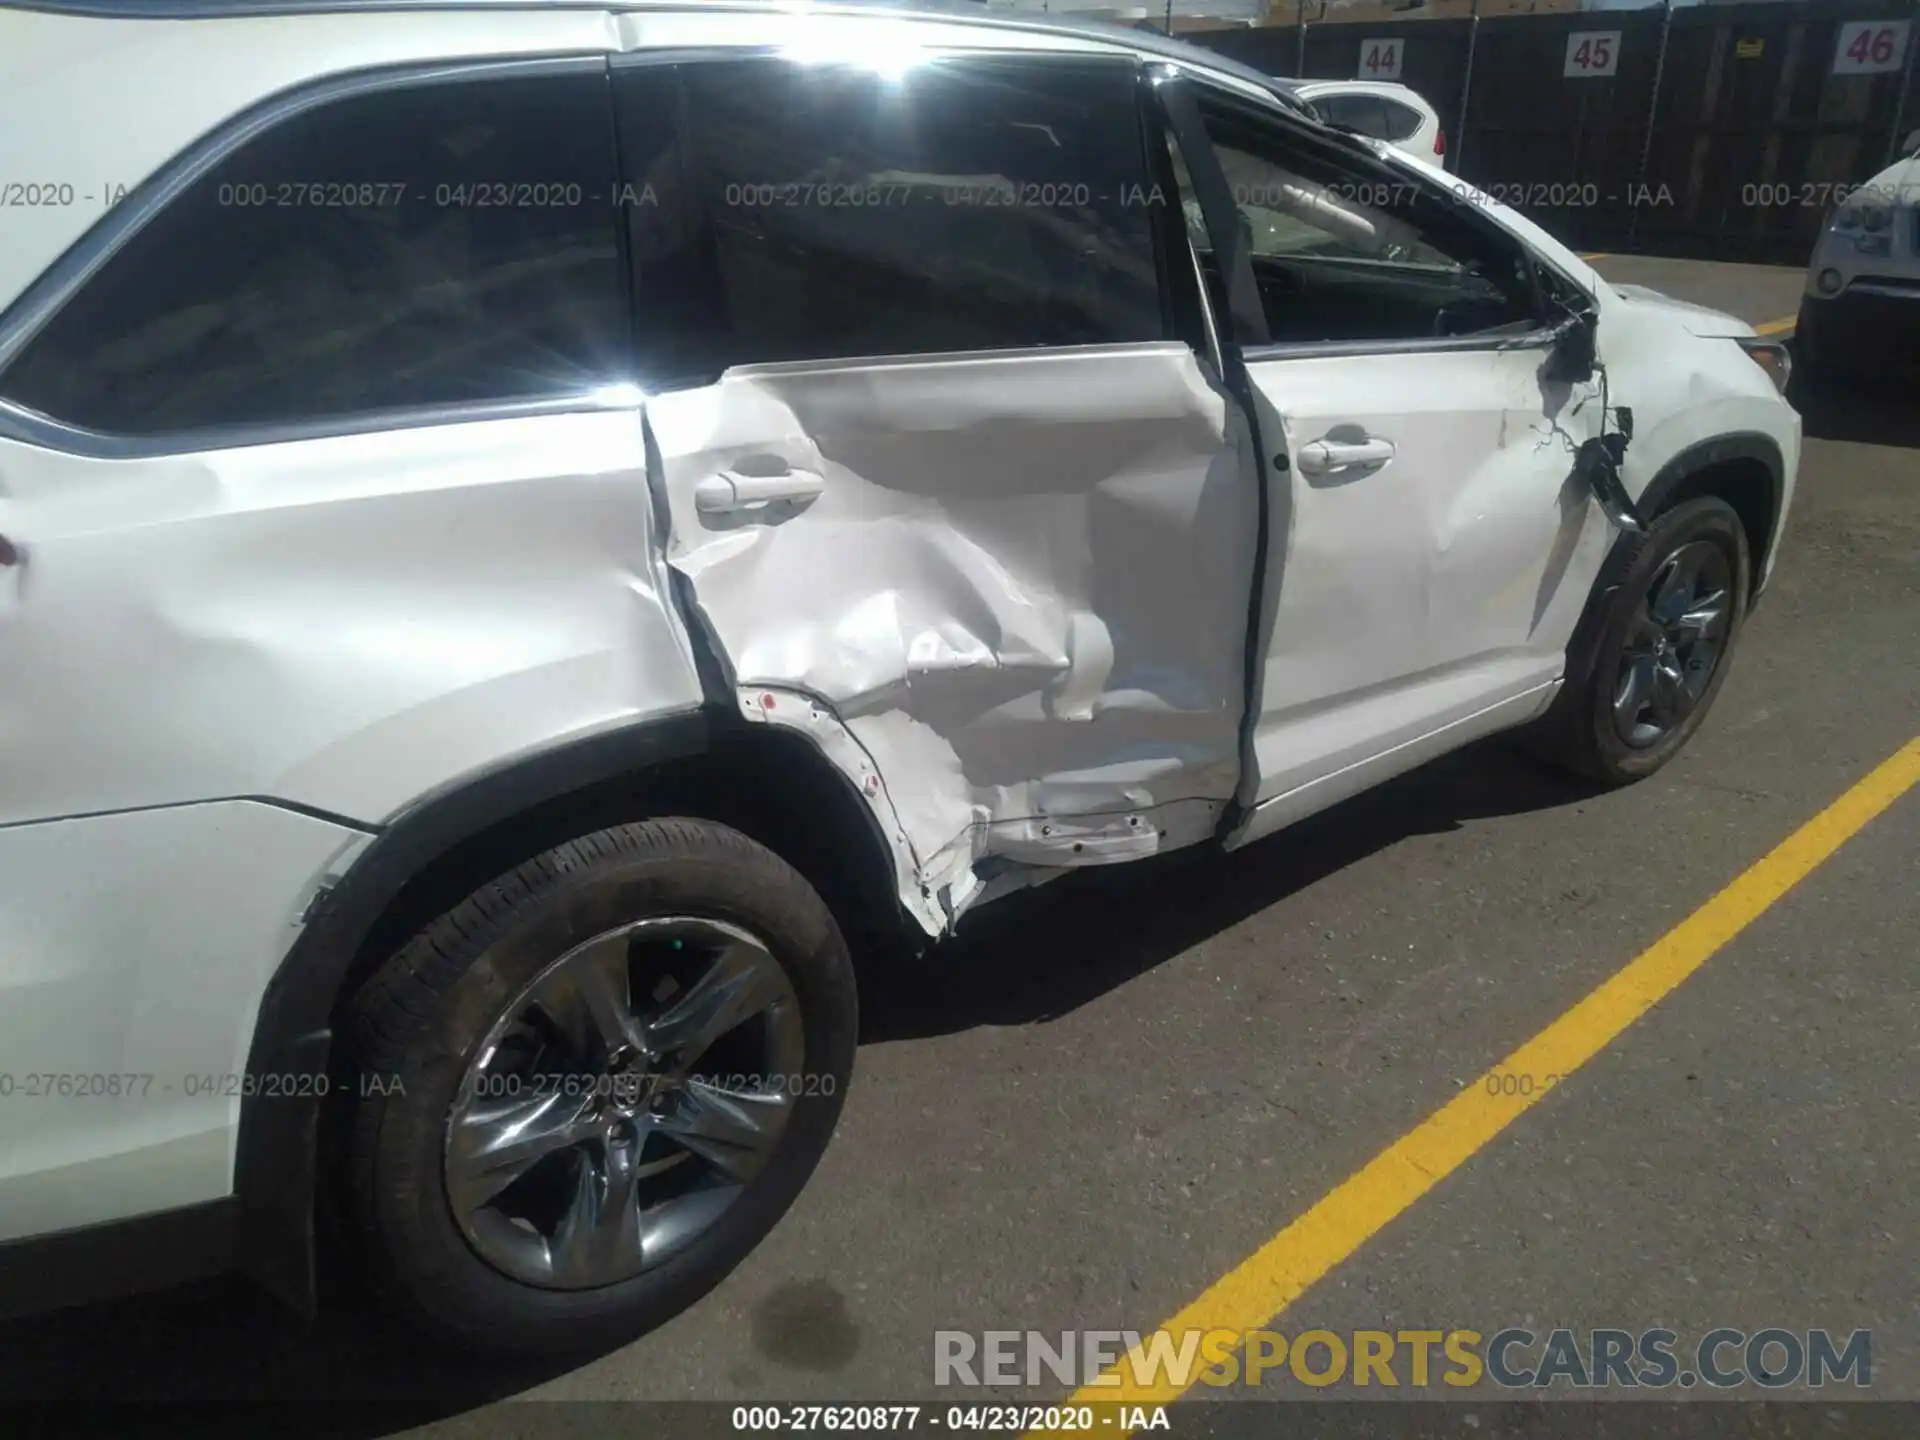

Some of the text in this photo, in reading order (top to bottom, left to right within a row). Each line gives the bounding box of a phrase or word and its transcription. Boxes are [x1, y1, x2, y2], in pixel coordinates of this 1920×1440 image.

[1365, 45, 1396, 73] 44
[1573, 37, 1612, 69] 45
[1848, 29, 1894, 65] 46
